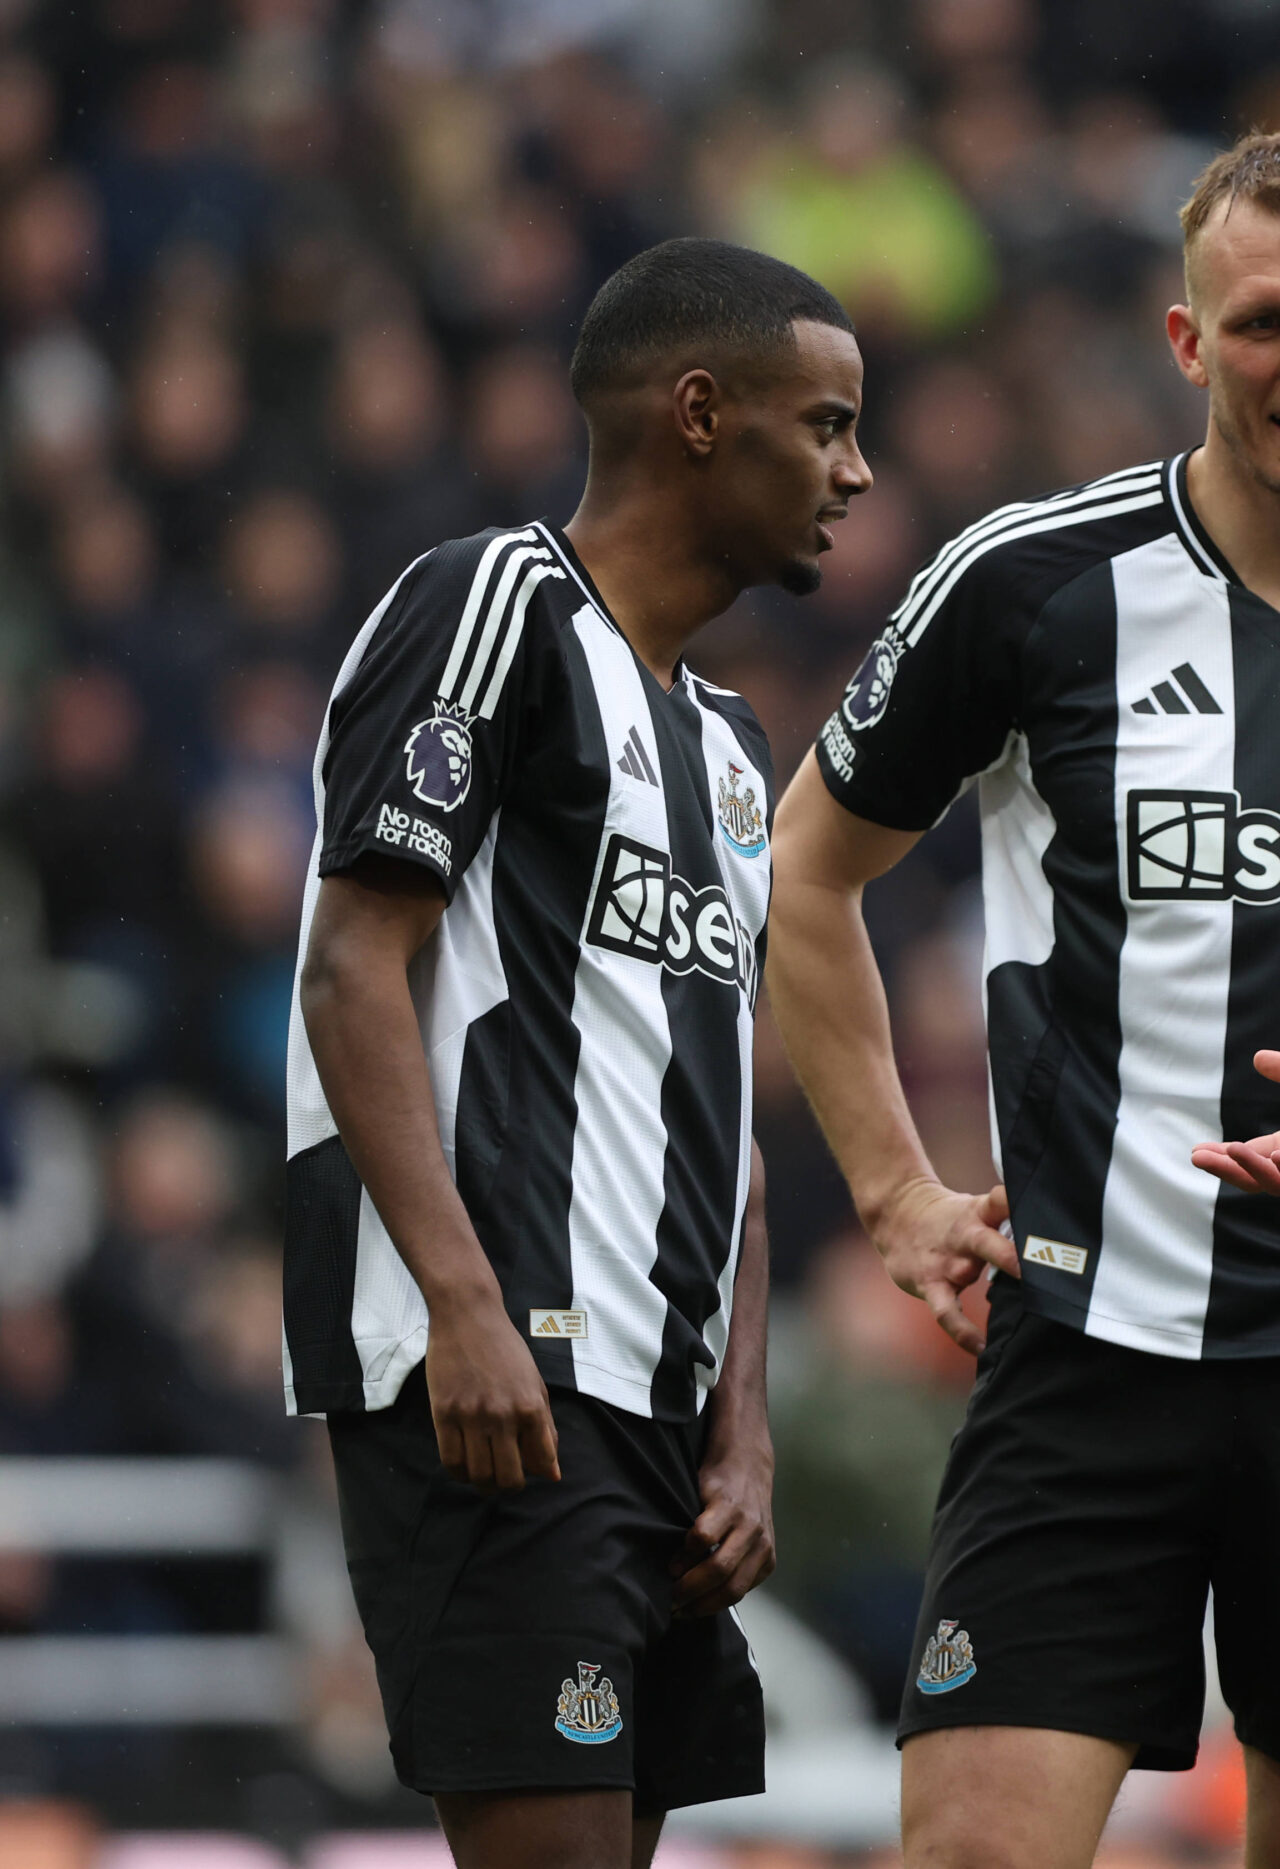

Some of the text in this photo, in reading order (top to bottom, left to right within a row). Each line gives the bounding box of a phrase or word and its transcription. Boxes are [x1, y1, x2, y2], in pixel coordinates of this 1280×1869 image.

[375, 821, 452, 877] for racism
[378, 803, 452, 856] No room
